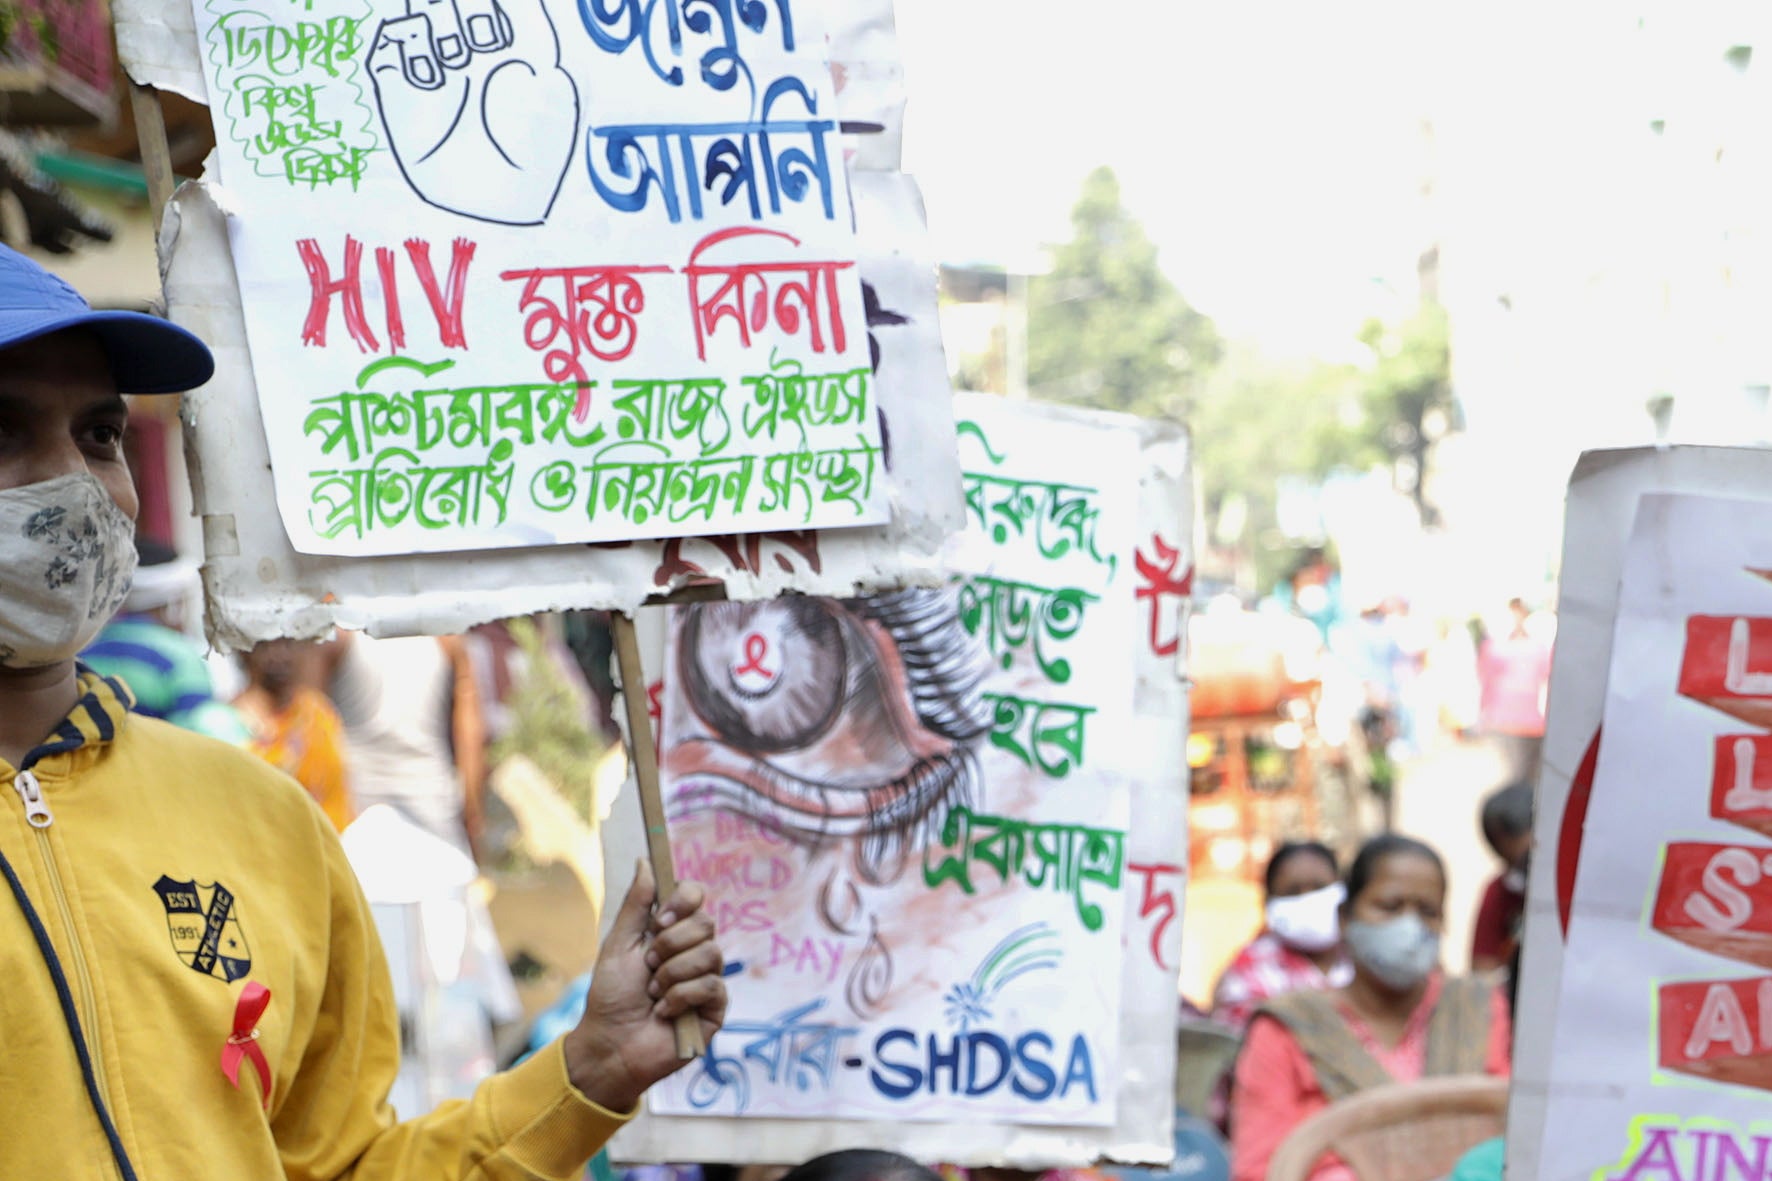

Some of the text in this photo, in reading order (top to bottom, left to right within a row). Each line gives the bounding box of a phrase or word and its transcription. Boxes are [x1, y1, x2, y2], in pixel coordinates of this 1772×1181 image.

[586, 74, 836, 223] আপনি
[296, 234, 477, 354] HIV
[531, 459, 578, 514] ও
[980, 692, 1097, 779] হবে
[166, 891, 197, 909] EST
[769, 930, 846, 983] DAY
